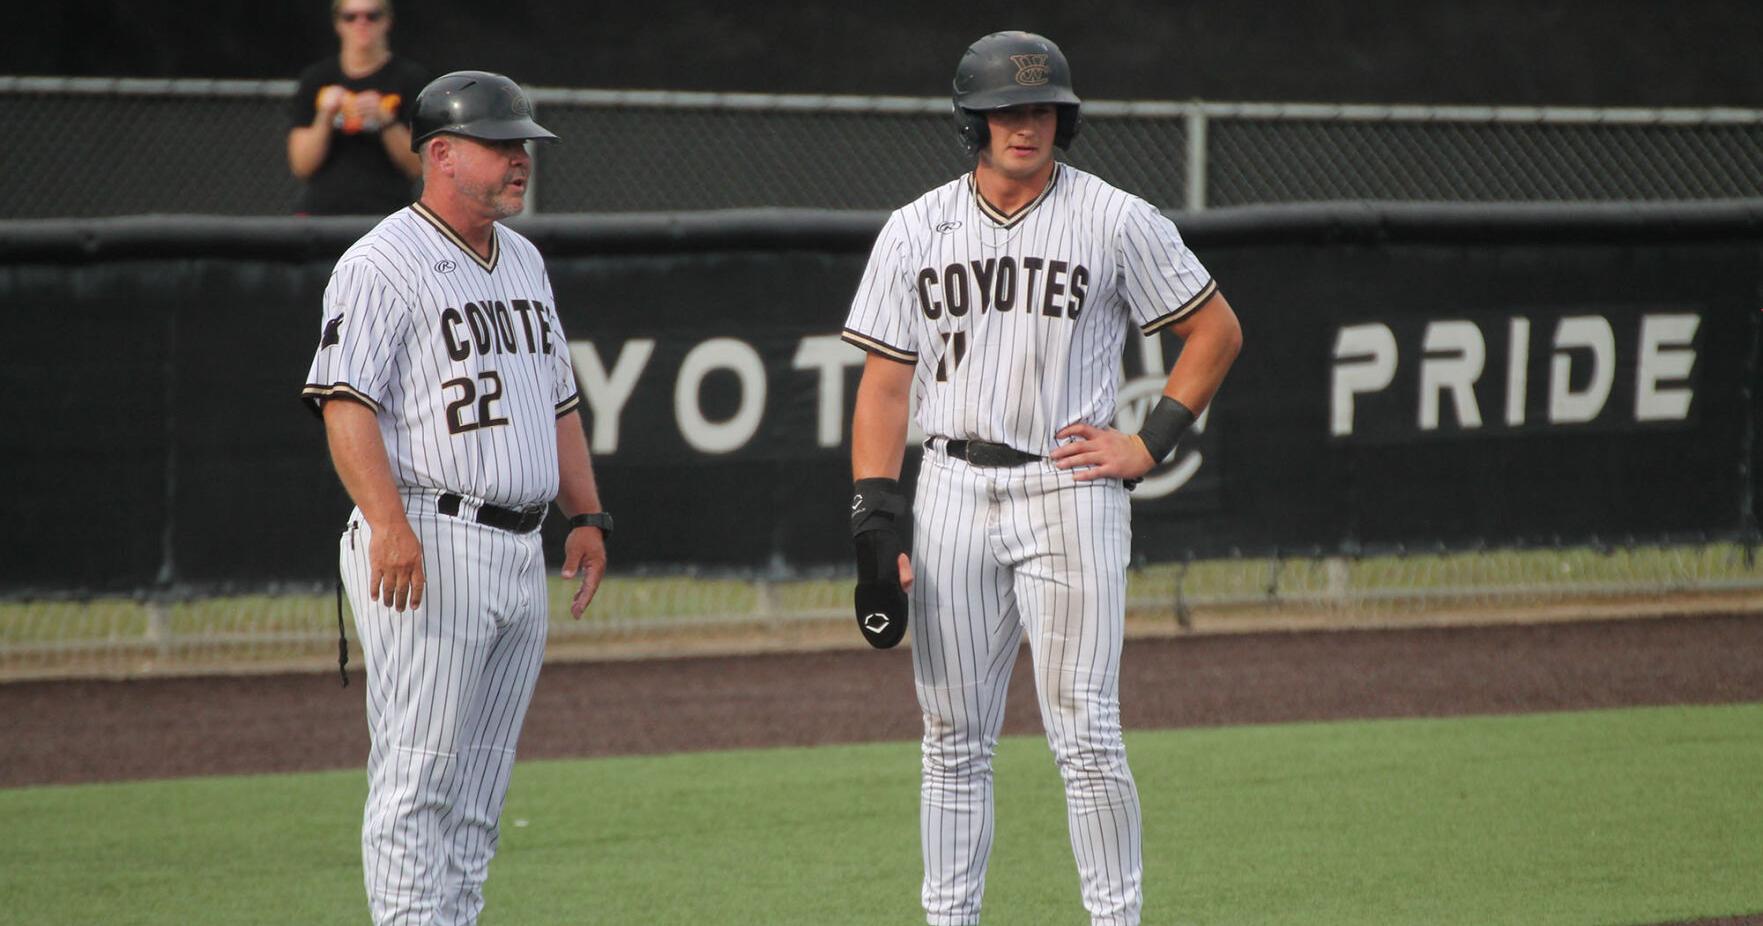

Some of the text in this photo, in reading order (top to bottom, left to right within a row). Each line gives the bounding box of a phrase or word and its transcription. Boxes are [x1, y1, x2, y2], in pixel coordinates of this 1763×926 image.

[917, 255, 1090, 321] COYOTES
[440, 299, 555, 363] COYOTE
[441, 370, 509, 435] 22
[568, 335, 926, 455] YOT
[1330, 314, 1701, 437] PRIDE
